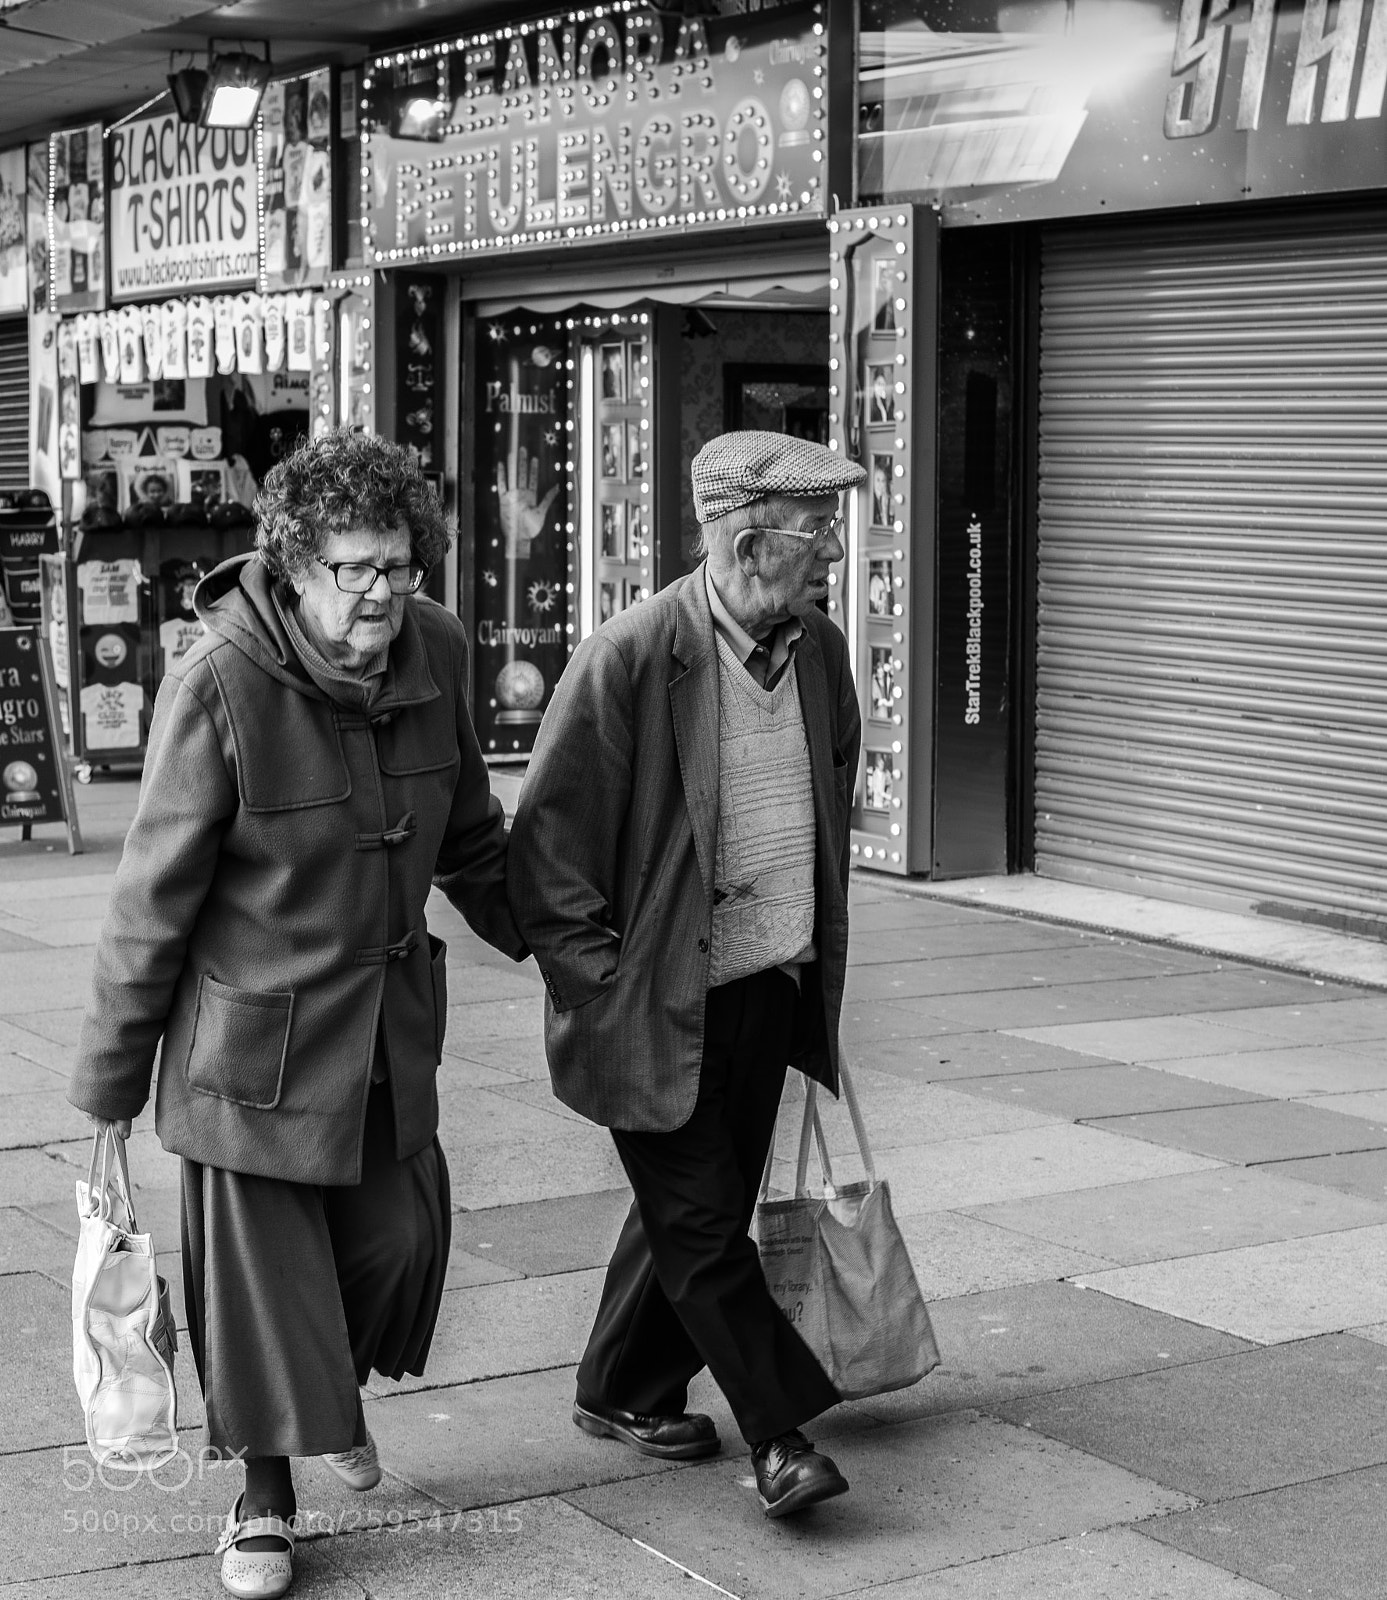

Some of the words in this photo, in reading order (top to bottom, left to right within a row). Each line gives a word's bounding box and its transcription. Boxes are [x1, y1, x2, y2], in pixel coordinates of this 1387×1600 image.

[433, 12, 716, 137] LEANORA
[393, 97, 775, 247] PETULENGRO
[128, 176, 246, 253] T-SHIRTS
[486, 380, 556, 415] Palmist
[10, 532, 45, 547] HARRY
[476, 619, 562, 647] Clairvoyant
[965, 522, 984, 725] StarTrekBlackpool.co.uk
[10, 725, 45, 744] Stars
